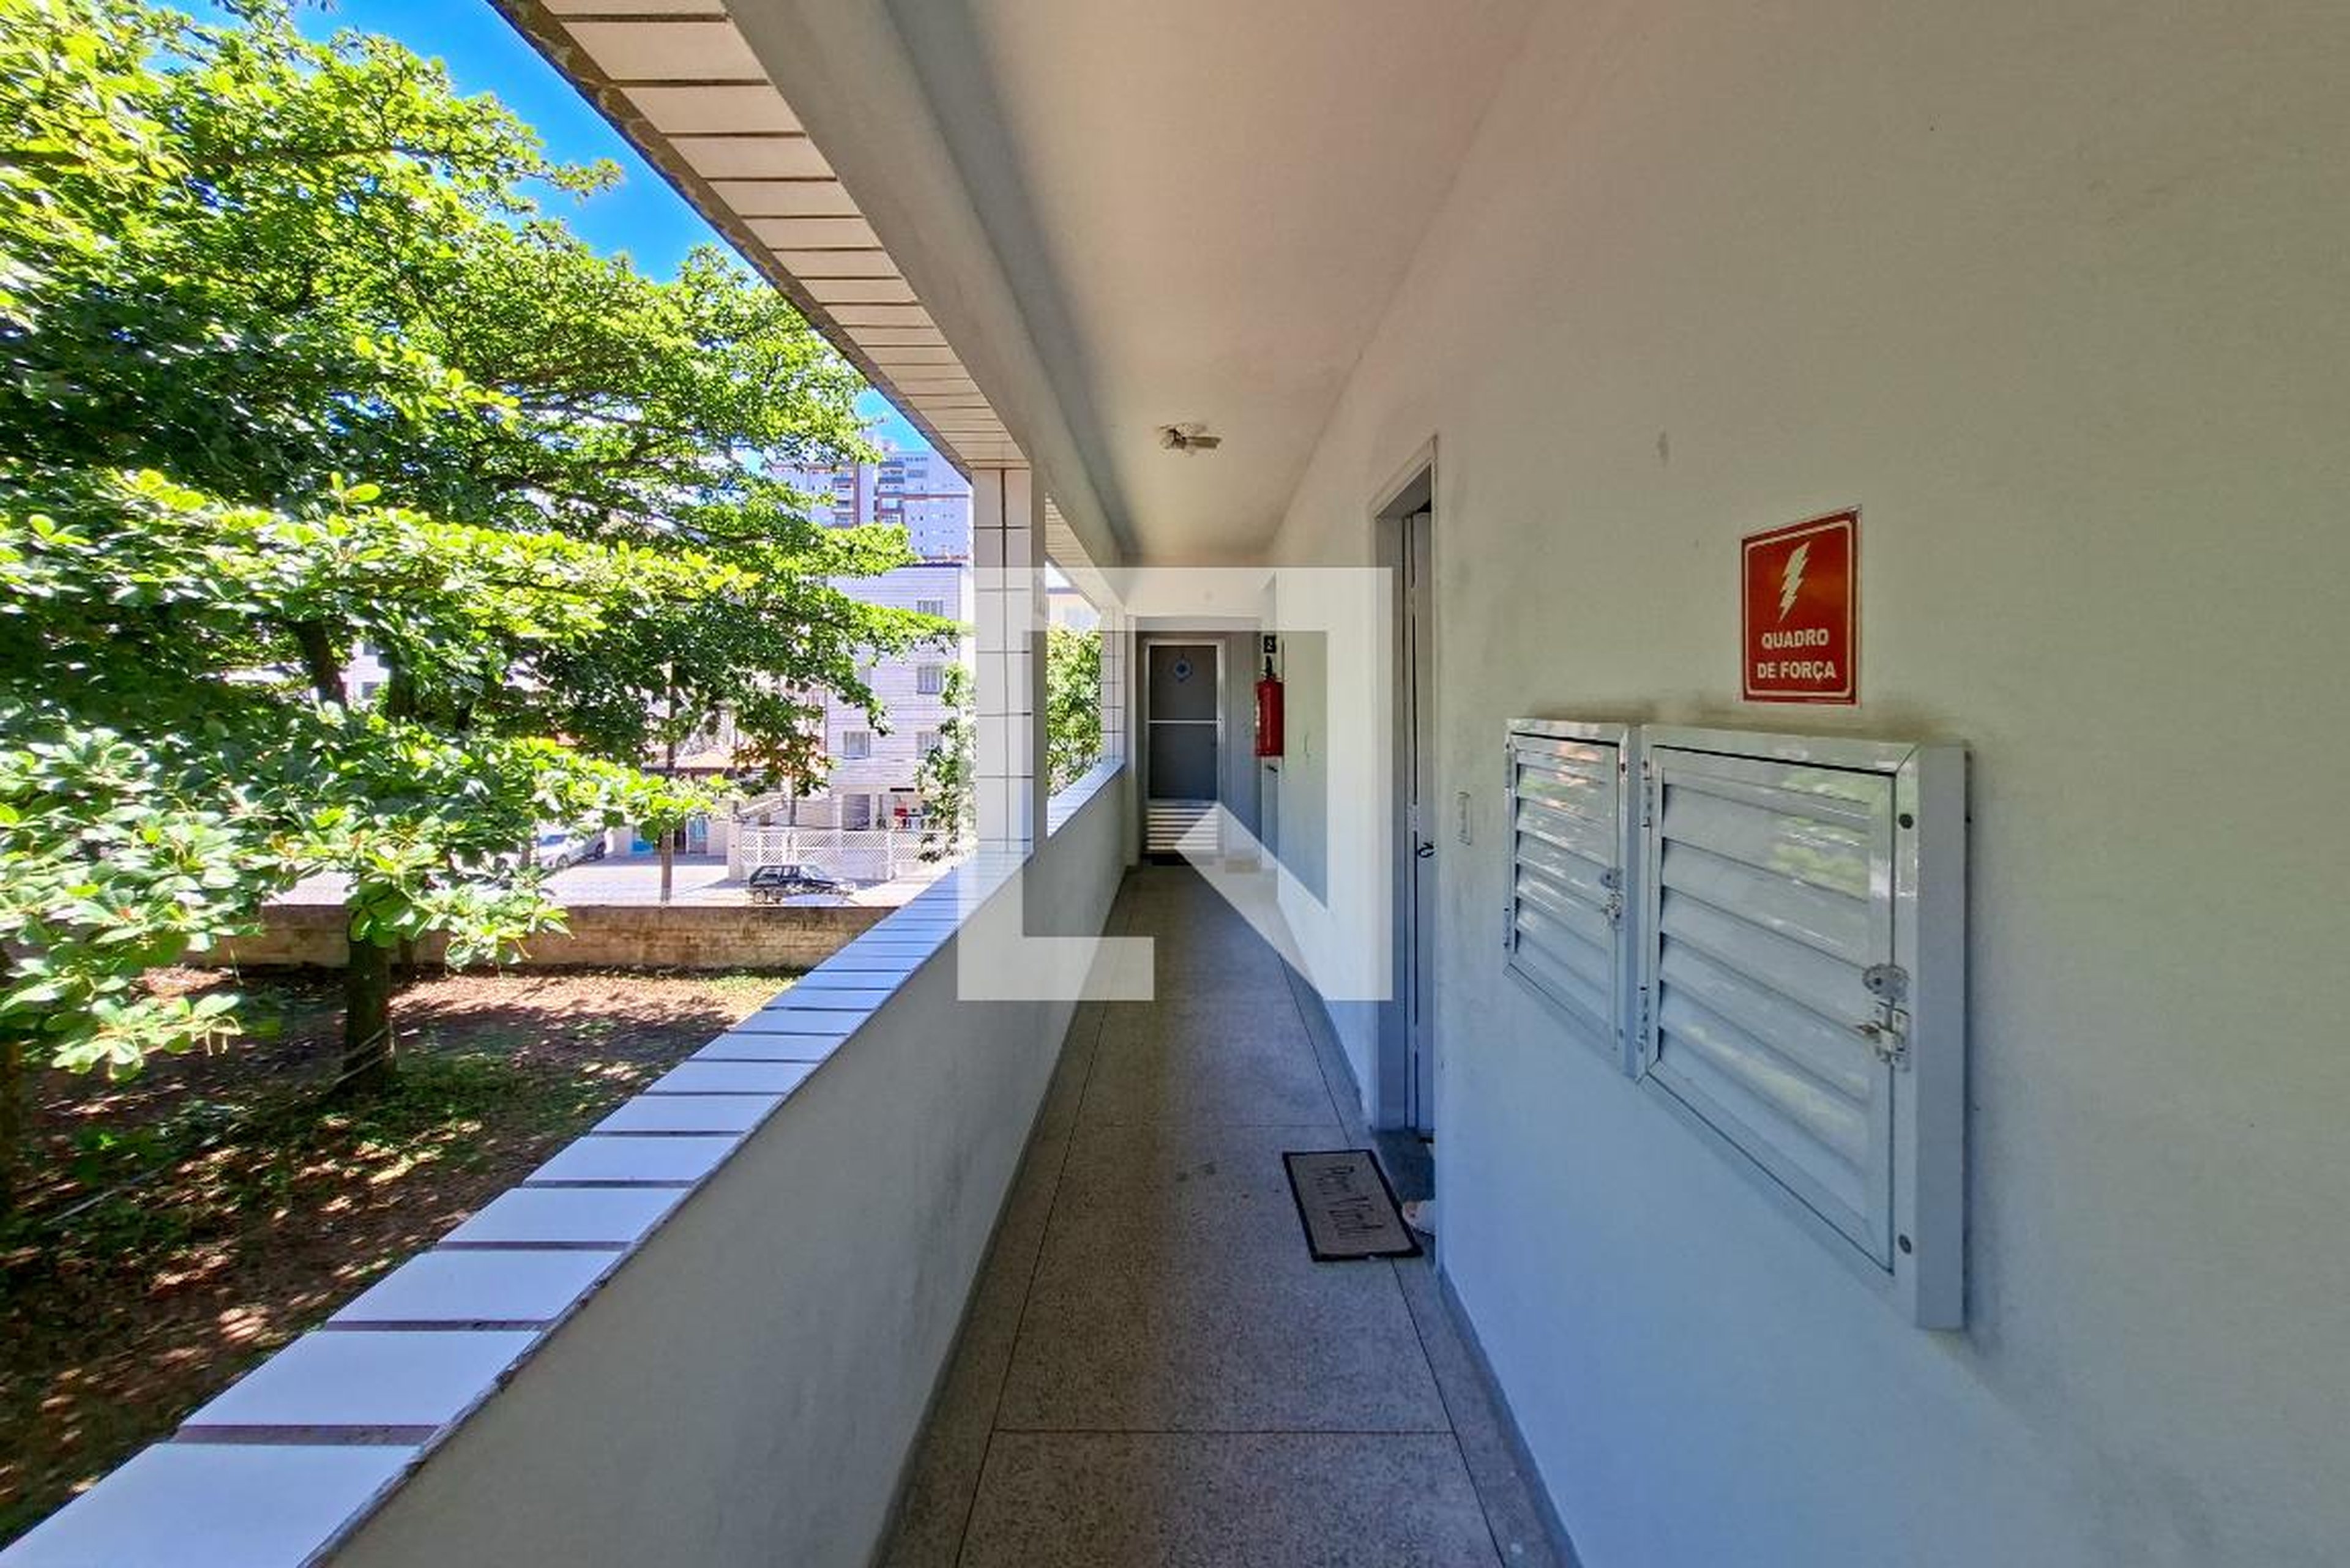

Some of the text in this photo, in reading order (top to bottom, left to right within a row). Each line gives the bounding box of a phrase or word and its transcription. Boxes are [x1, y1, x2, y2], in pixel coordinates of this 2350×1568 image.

[1761, 628, 1829, 649] QUADRO
[1757, 660, 1837, 681] DE FORÇA
